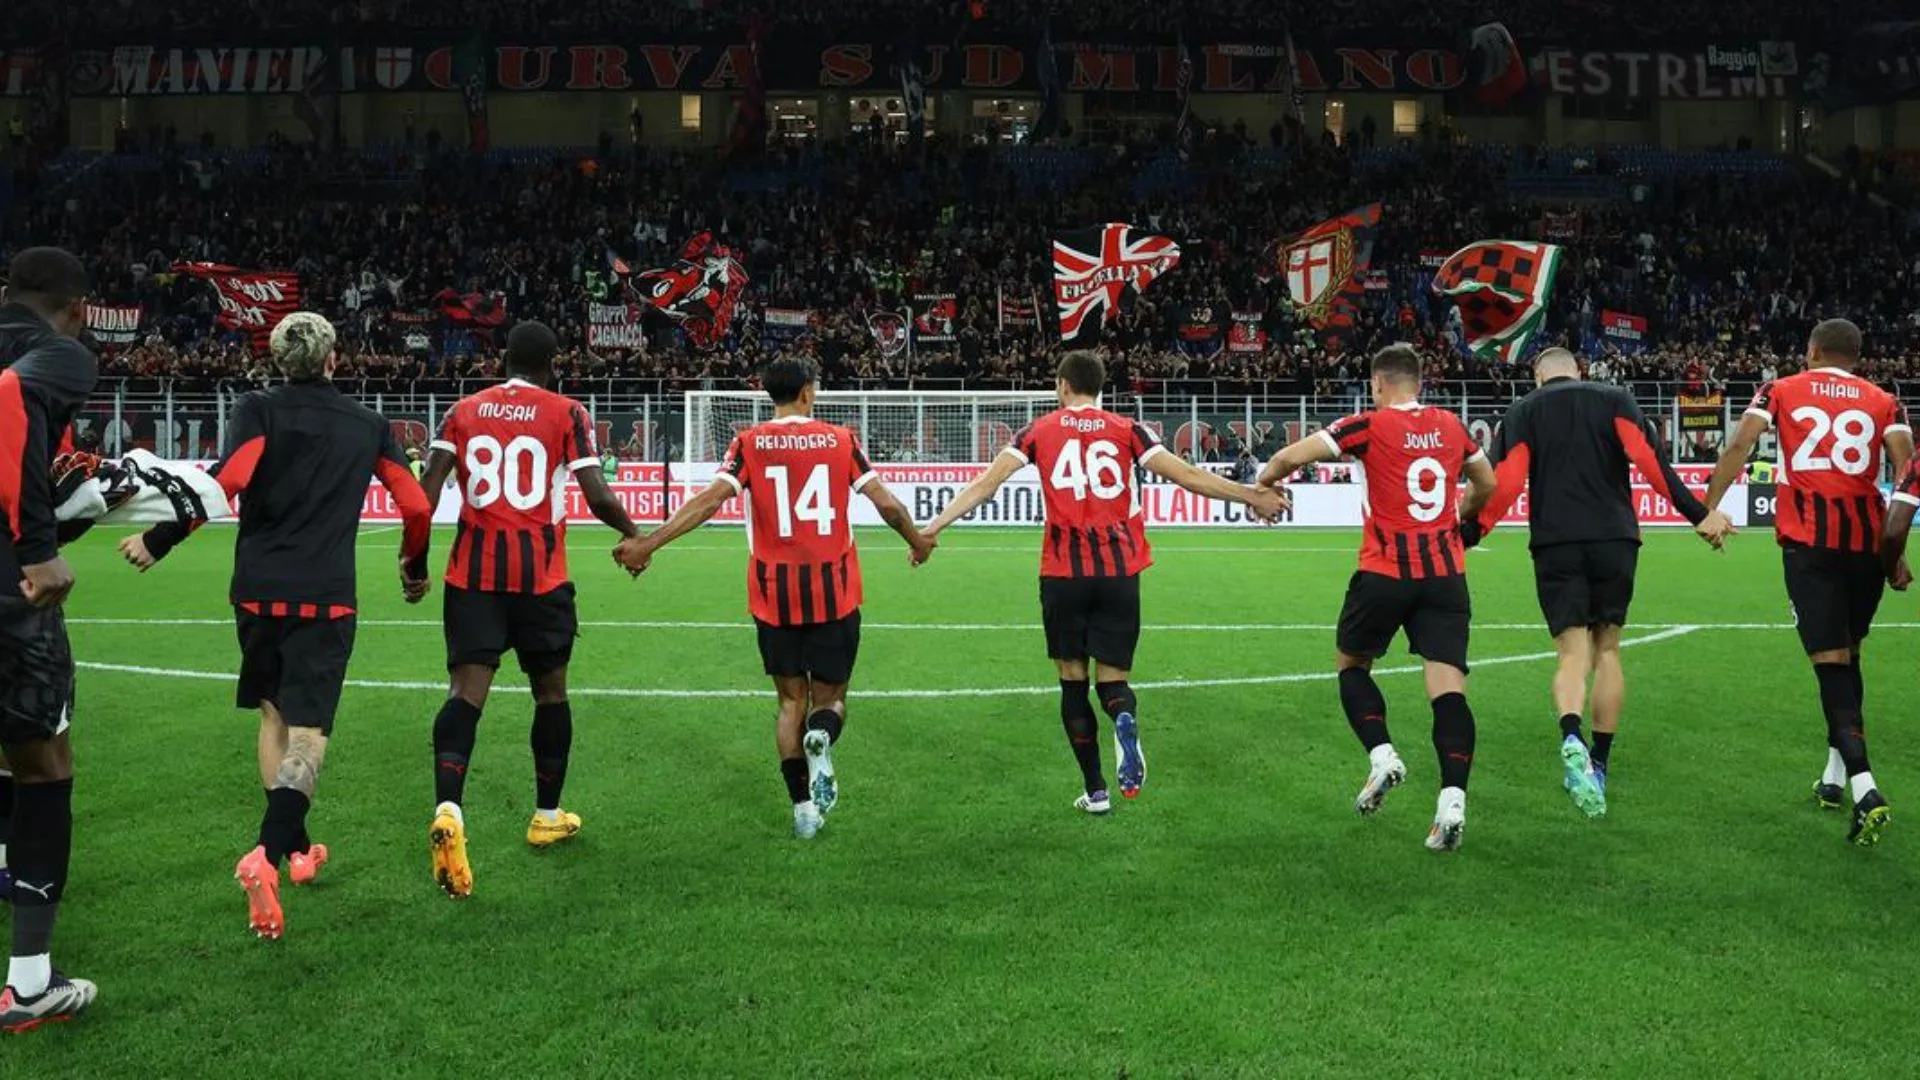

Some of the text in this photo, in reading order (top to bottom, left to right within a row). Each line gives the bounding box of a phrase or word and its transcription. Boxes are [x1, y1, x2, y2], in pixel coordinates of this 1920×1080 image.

[479, 401, 536, 421] MUSAH
[1810, 381, 1860, 399] THIAW
[1050, 438, 1124, 501] 46
[1404, 427, 1444, 453] JOVIĆ
[1791, 406, 1875, 479] 28
[466, 436, 547, 510] 80
[765, 464, 836, 537] 14
[1406, 456, 1447, 523] 9
